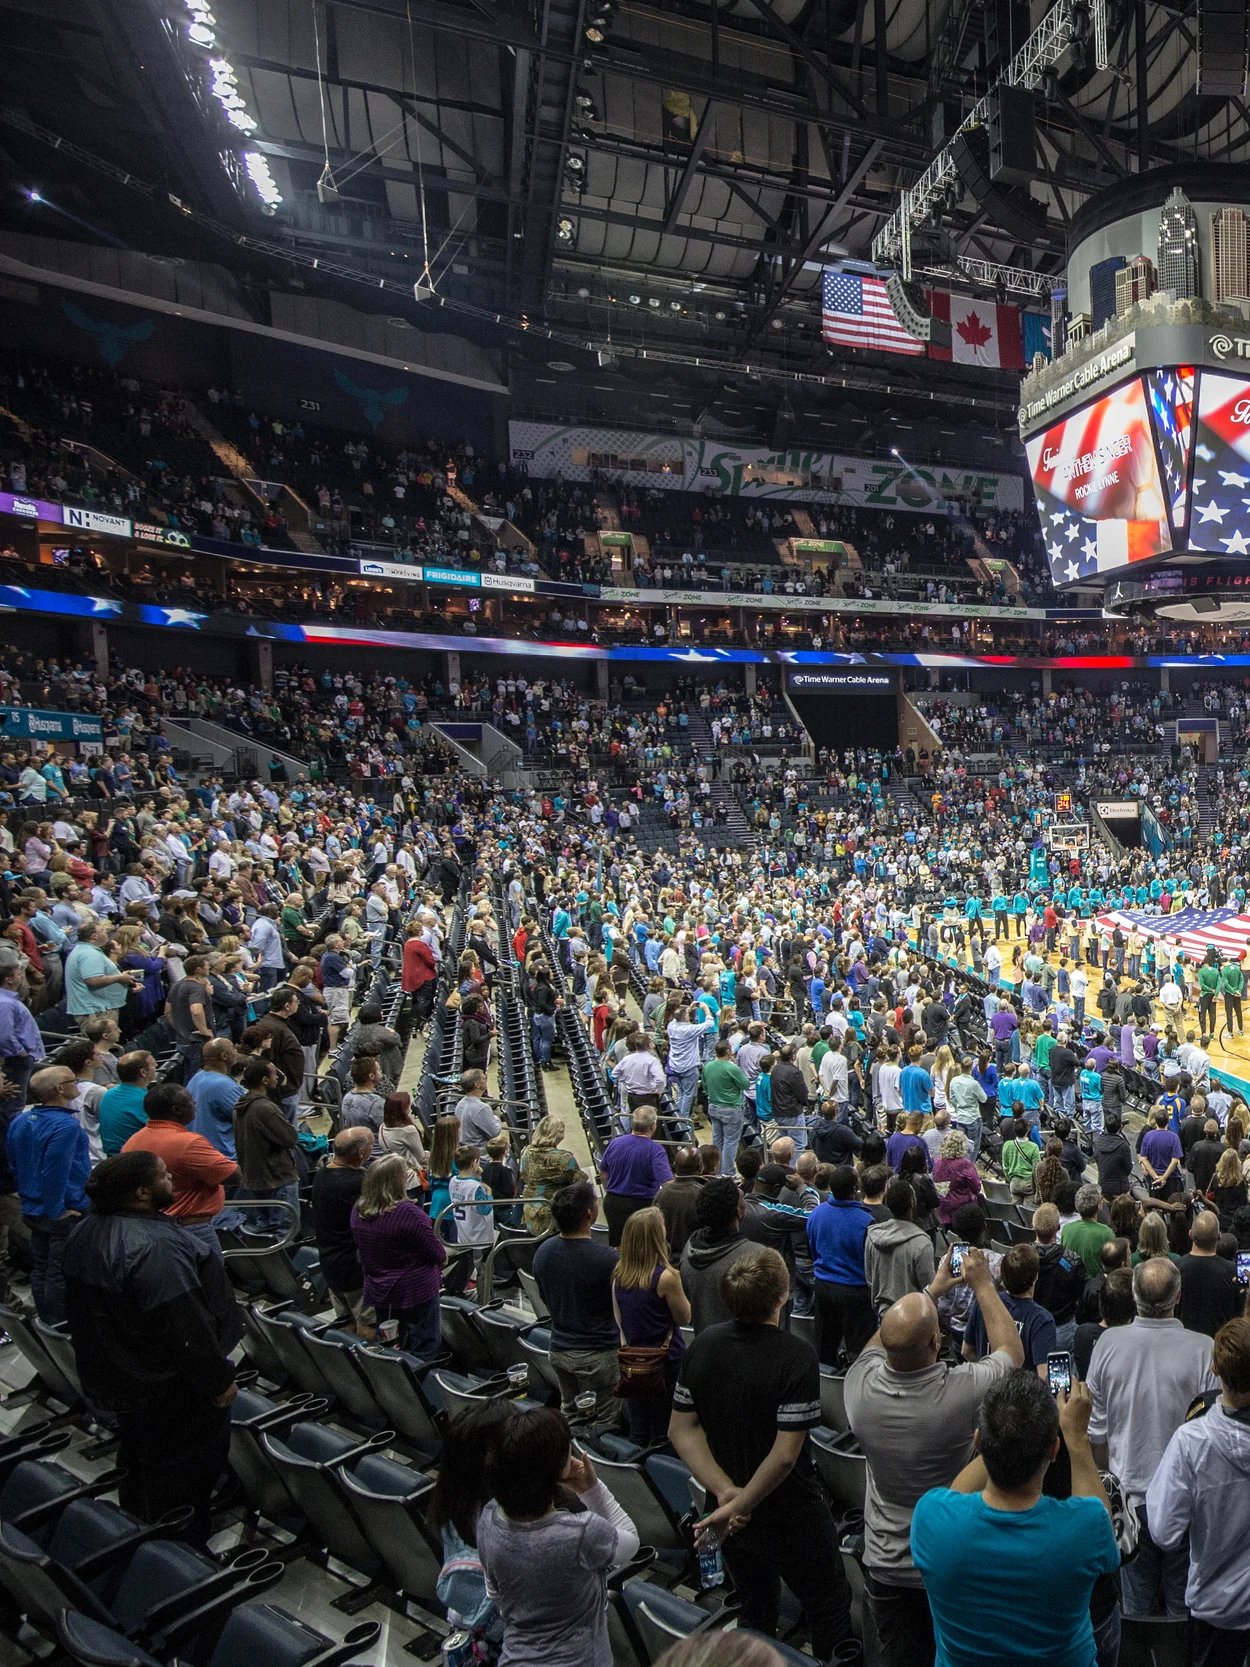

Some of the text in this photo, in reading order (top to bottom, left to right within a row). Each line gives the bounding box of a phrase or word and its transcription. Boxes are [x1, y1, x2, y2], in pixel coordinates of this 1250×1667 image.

[1026, 345, 1131, 418] Time Warner Cable Arena
[300, 399, 320, 412] 231
[514, 450, 533, 460] 232
[701, 468, 718, 477] 233
[866, 484, 879, 492] 201
[92, 514, 126, 527] NOVANT
[426, 570, 478, 583] FRIGIDAIRE
[492, 577, 532, 589] Husqvarna
[803, 675, 821, 683] Time
[867, 676, 889, 684] Arena
[1057, 800, 1069, 810] 24
